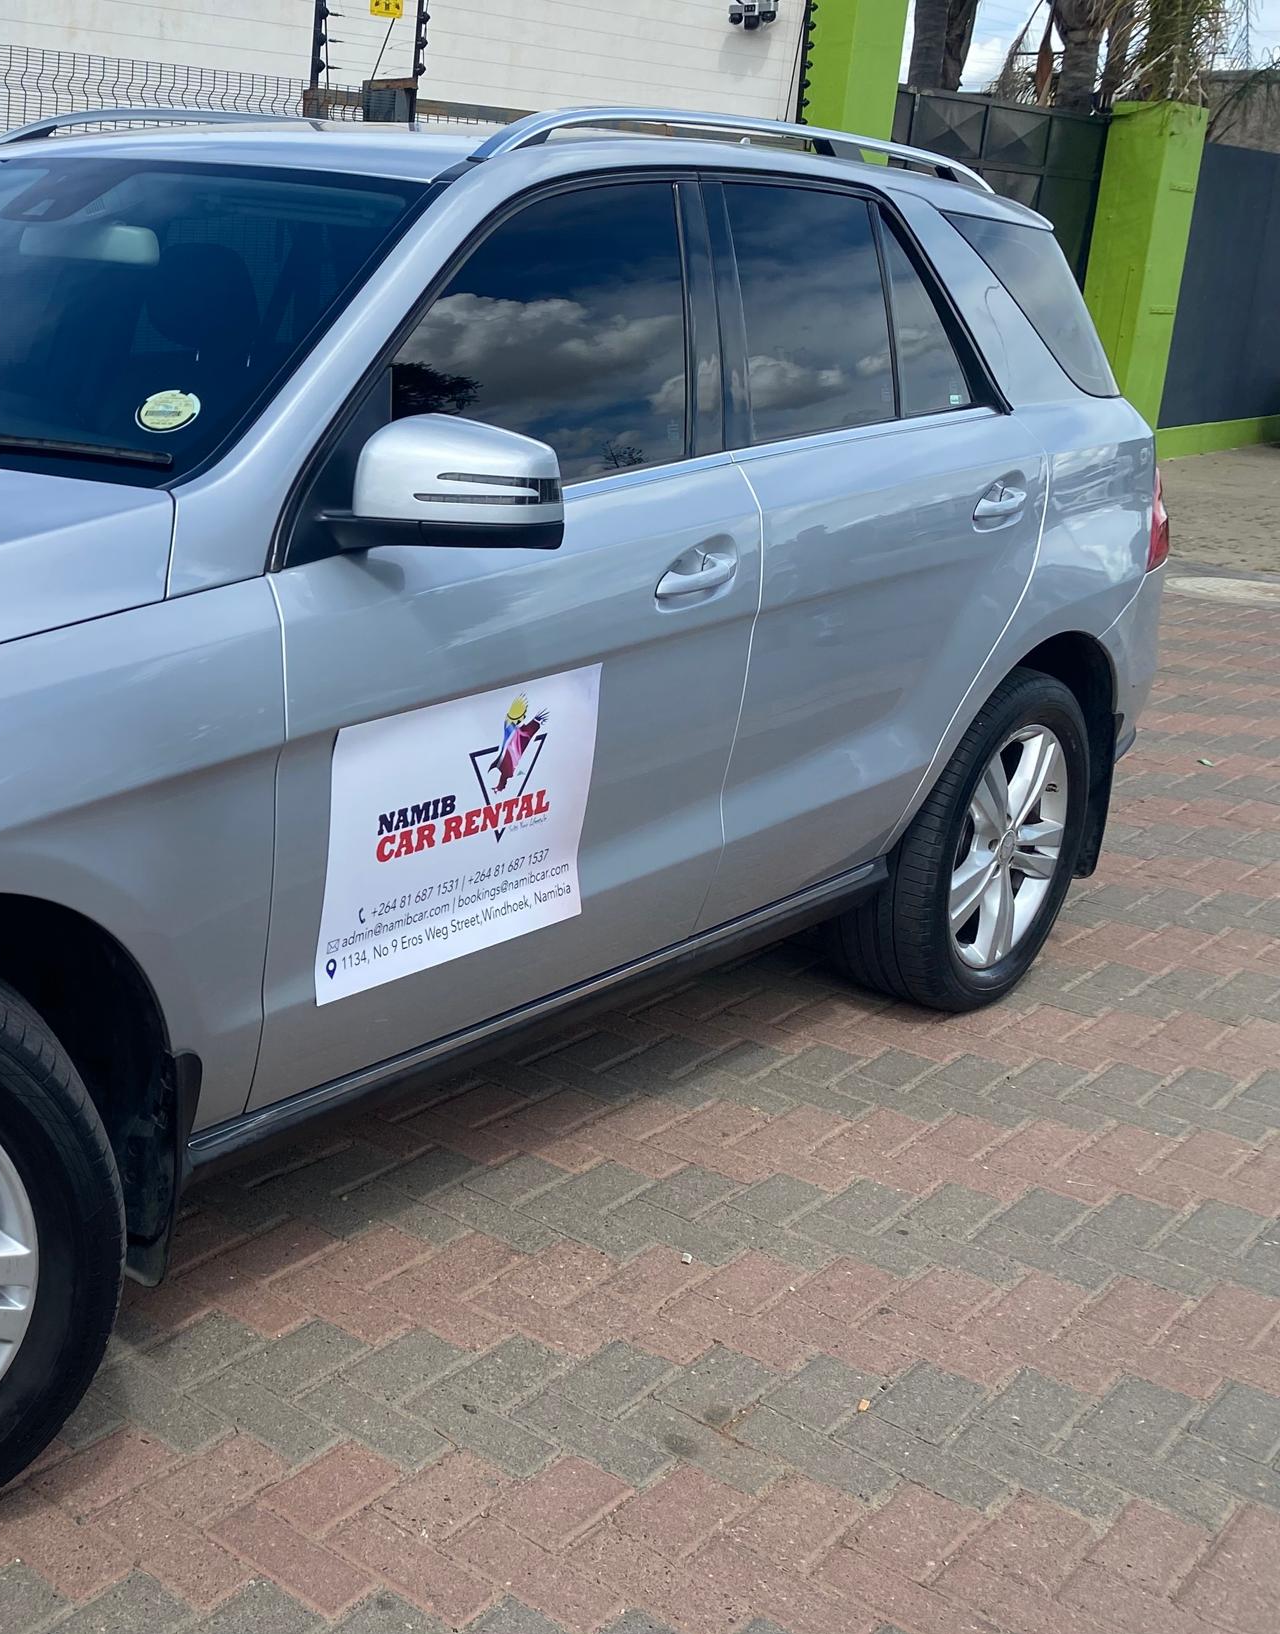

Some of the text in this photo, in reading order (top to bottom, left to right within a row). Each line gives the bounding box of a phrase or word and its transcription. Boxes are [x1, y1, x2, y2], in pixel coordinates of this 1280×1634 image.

[376, 789, 550, 862] CAR RENTAL
[377, 794, 456, 836] NAMIB
[341, 903, 450, 948] admin@namibcar.com
[457, 863, 570, 908] bookings@namibcar.com
[371, 898, 397, 918] +264
[399, 893, 412, 909] 81
[414, 886, 433, 904] 687
[437, 878, 459, 896] 1531
[468, 867, 492, 885] +264
[493, 863, 505, 877] 81
[507, 856, 525, 873] 687
[528, 848, 550, 865] 1537
[341, 949, 370, 970] 1134,
[373, 944, 389, 959] No
[391, 938, 398, 952] 9
[401, 933, 423, 950] Eros
[424, 925, 449, 940] Weg
[534, 883, 571, 905] Namibia
